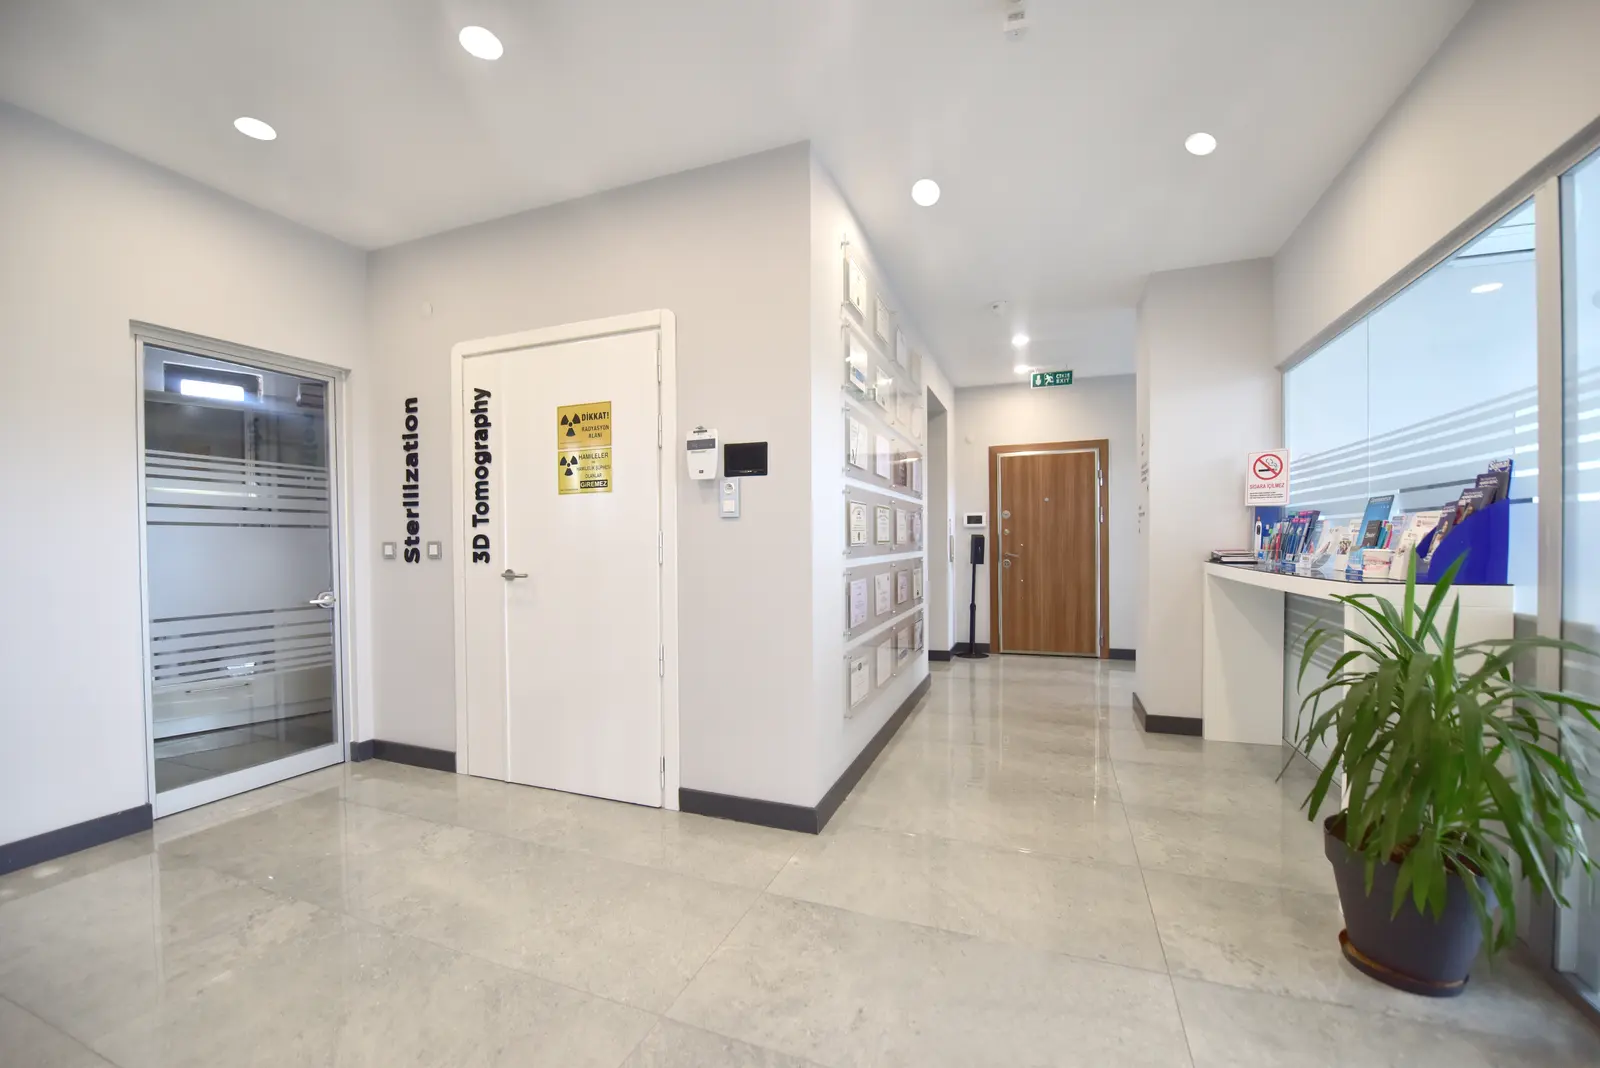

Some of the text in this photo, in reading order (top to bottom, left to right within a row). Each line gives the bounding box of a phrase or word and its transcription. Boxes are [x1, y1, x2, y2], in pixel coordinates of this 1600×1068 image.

[402, 397, 420, 563] Sterilization
[470, 388, 492, 563] 3D Tomography
[582, 412, 610, 421] DİKKAT!
